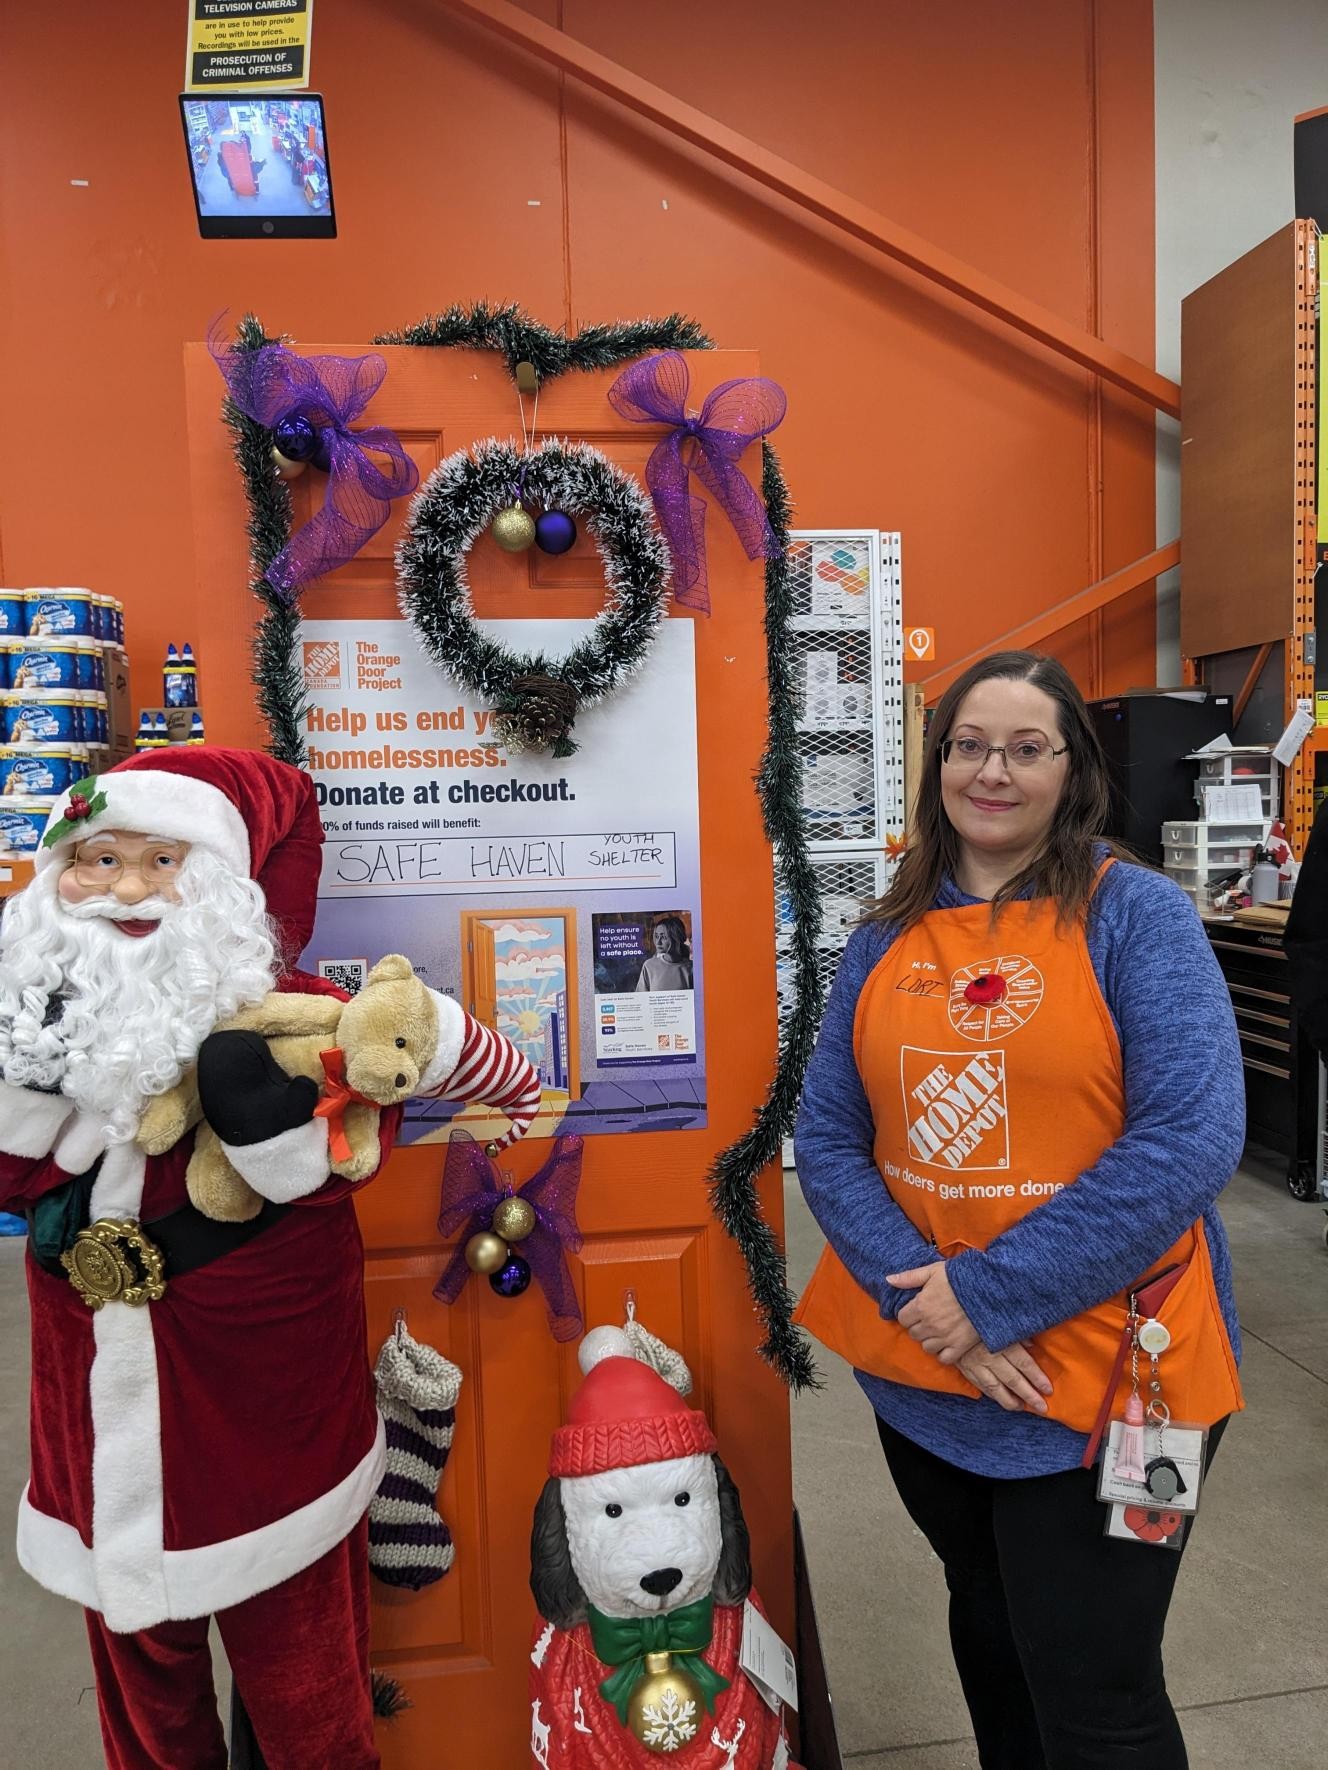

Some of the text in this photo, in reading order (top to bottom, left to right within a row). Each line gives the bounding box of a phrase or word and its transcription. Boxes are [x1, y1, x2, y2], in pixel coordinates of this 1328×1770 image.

[204, 0, 298, 14] TELEVISION CAMERAS
[205, 16, 295, 30] are in use to help provide
[214, 27, 285, 40] you with low prices.
[198, 36, 300, 50] Recordings will be used in the
[210, 52, 287, 66] PROSECUTION OF
[202, 64, 293, 78] CRIMINAL OFFENSES
[356, 641, 379, 653] The
[304, 640, 340, 677] HOME
[357, 654, 401, 668] Orange
[357, 666, 386, 677] Door
[358, 678, 402, 692] Project
[307, 707, 367, 737] Help
[376, 711, 408, 731] us
[416, 706, 465, 731] end
[308, 745, 507, 769] homelessness.
[315, 778, 576, 806] Donate at checkout.
[342, 820, 352, 831] of
[355, 820, 384, 831] funds
[387, 819, 419, 830] raised
[421, 818, 440, 828] will
[443, 817, 481, 828] benefit:
[604, 833, 654, 845] YOUTH
[337, 841, 565, 883] SAFE HAVEN
[588, 847, 665, 866] SHELTER
[911, 1063, 953, 1107] THE
[909, 1052, 1005, 1162] HOME
[941, 1094, 1008, 1169] DEPOT
[884, 1161, 900, 1180] How
[902, 1167, 935, 1193] doers
[939, 1183, 965, 1200] get
[968, 1184, 1016, 1199] more
